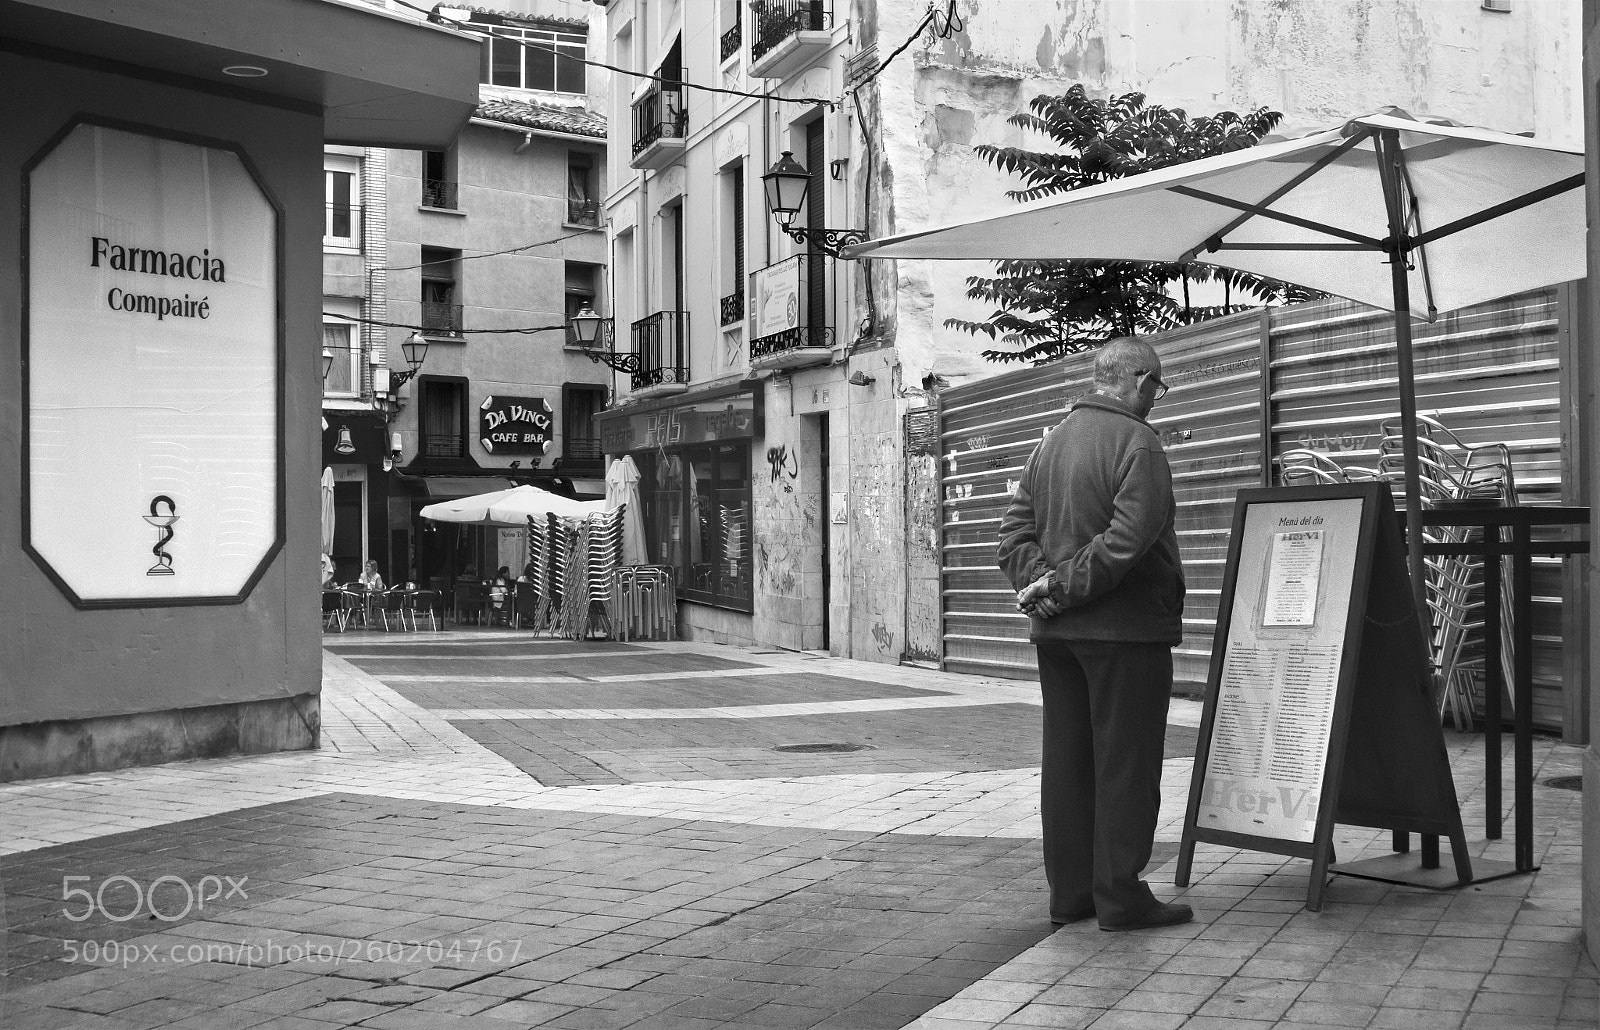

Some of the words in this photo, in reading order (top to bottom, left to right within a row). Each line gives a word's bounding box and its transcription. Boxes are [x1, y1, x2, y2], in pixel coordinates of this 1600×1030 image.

[90, 236, 226, 283] Farmacia
[107, 287, 210, 321] Compairé
[484, 410, 509, 430] DA
[509, 405, 551, 431] VINCI
[491, 432, 518, 443] CAFE
[523, 433, 544, 443] BAR
[1278, 517, 1299, 526] Menú
[1299, 516, 1312, 526] del
[1312, 515, 1325, 525] día
